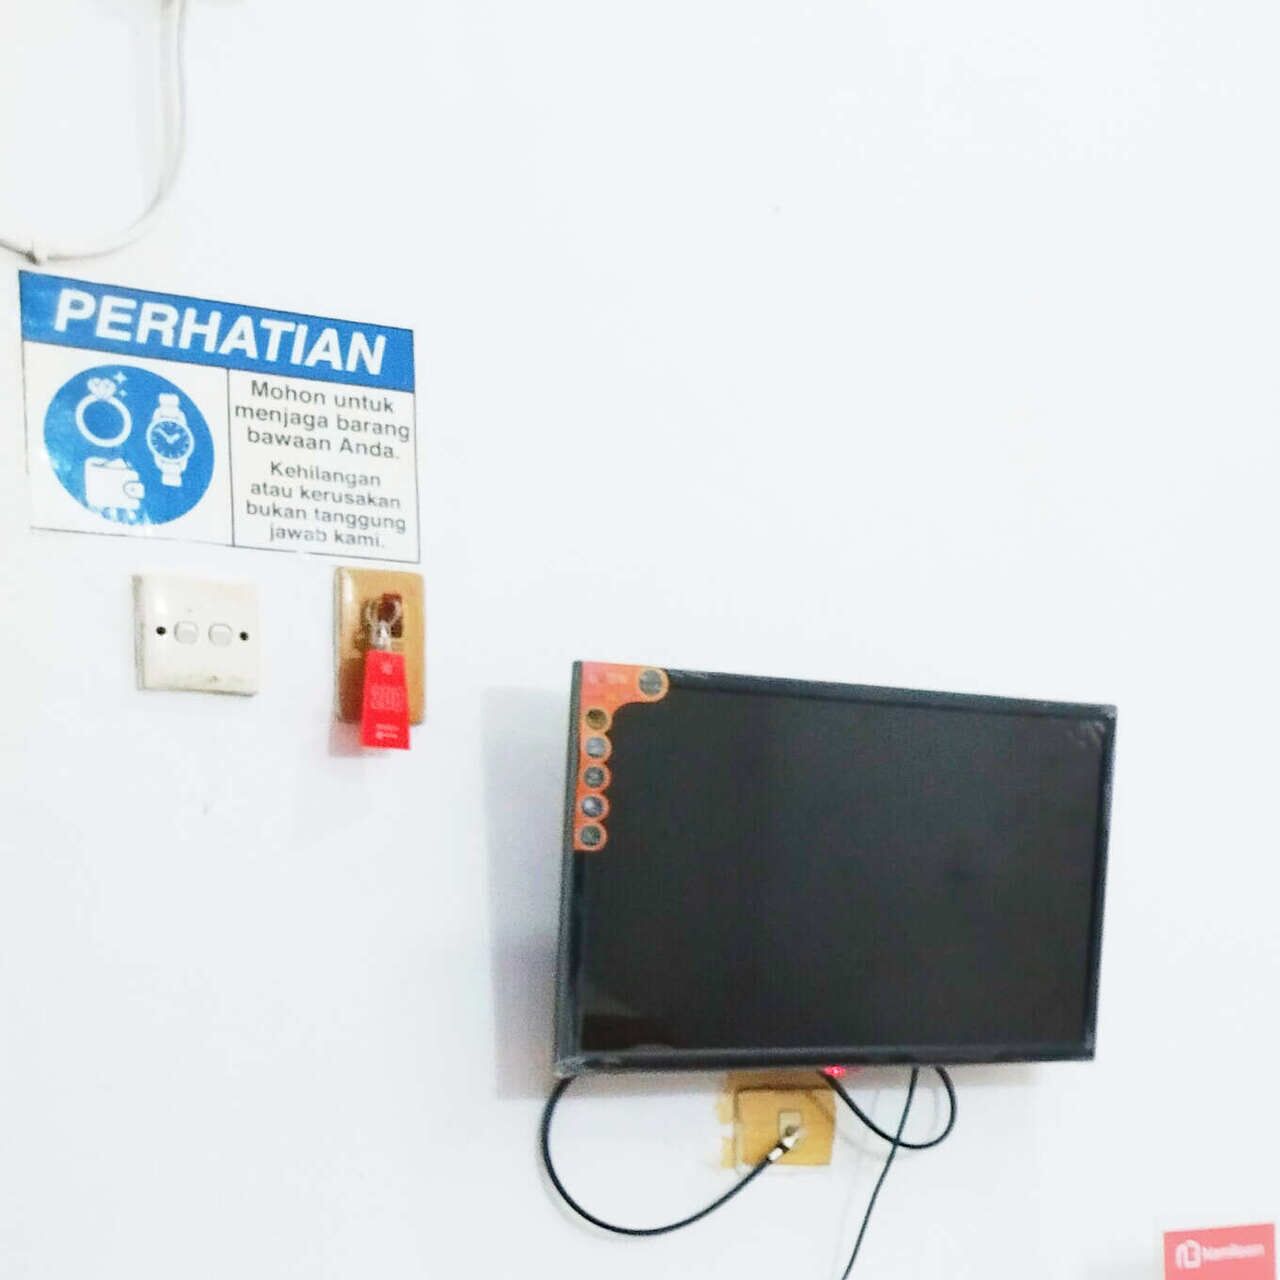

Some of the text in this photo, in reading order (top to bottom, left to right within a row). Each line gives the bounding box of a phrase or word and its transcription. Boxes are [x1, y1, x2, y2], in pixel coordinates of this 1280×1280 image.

[54, 288, 387, 376] PERHATIAN
[250, 379, 394, 413] Mohon untuk
[234, 404, 410, 442] menjaga barang
[247, 427, 400, 460] bawaan Anda.
[270, 461, 381, 488] Kehilangan
[250, 483, 400, 510] atau kerusakan
[246, 500, 406, 534] bukan tanggung
[270, 524, 385, 549] jawab kami.
